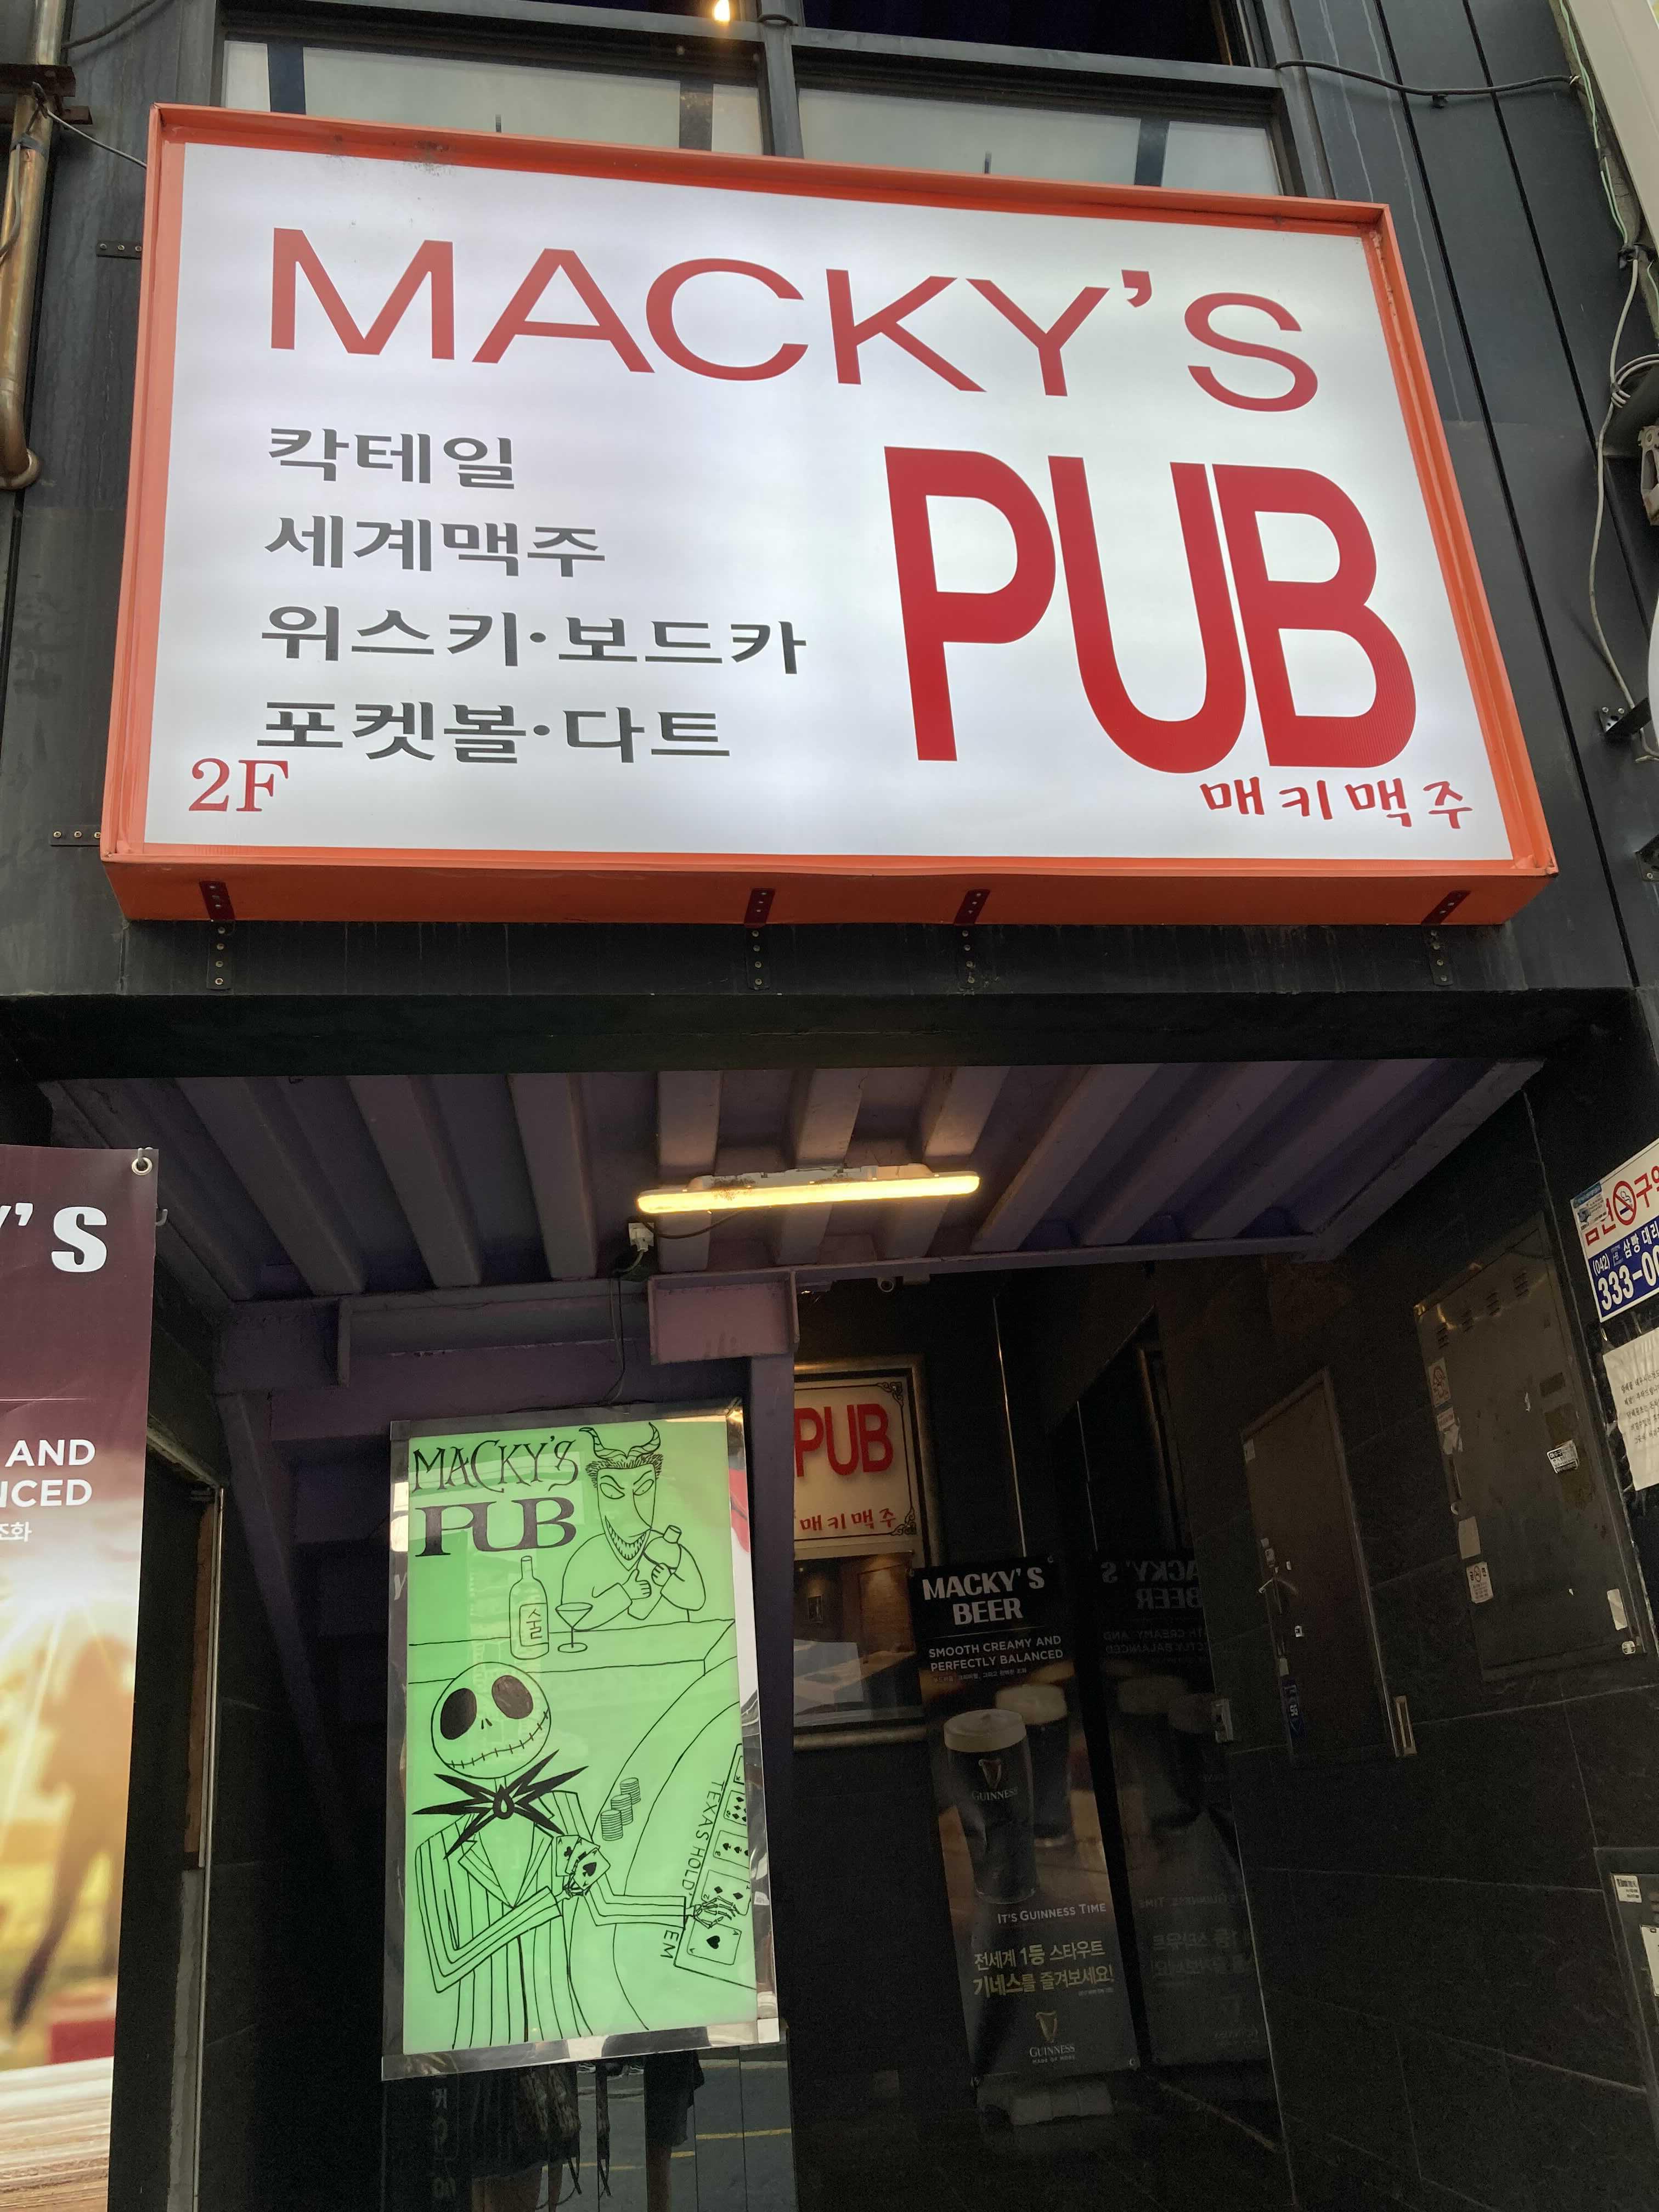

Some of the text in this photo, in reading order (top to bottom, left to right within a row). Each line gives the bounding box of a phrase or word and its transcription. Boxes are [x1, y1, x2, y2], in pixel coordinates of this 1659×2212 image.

[270, 227, 1318, 411] MACKY'S
[268, 428, 515, 489] 칵테일
[264, 515, 606, 578] 세계맥주
[884, 445, 1417, 774] PUB
[188, 757, 289, 812] 2F
[4, 1439, 95, 1467] AND
[411, 1435, 579, 1493] MACKY'S
[794, 1403, 894, 1477] PUB
[415, 1497, 577, 1558] PUB
[526, 1608, 543, 1640] 술
[952, 1598, 1023, 1626] BEER
[928, 1635, 1062, 1658] SMOOTH CREAMY AND
[930, 1649, 1064, 1672] PERFECTLY BALANCED
[695, 1781, 725, 1841] TEXAS
[997, 1903, 1107, 1924] IT'S GUINNESS TIME
[973, 1964, 1115, 1998] 기네스를 즐겨보세요!
[974, 1940, 1106, 1971] 전세계 1등 스타우트
